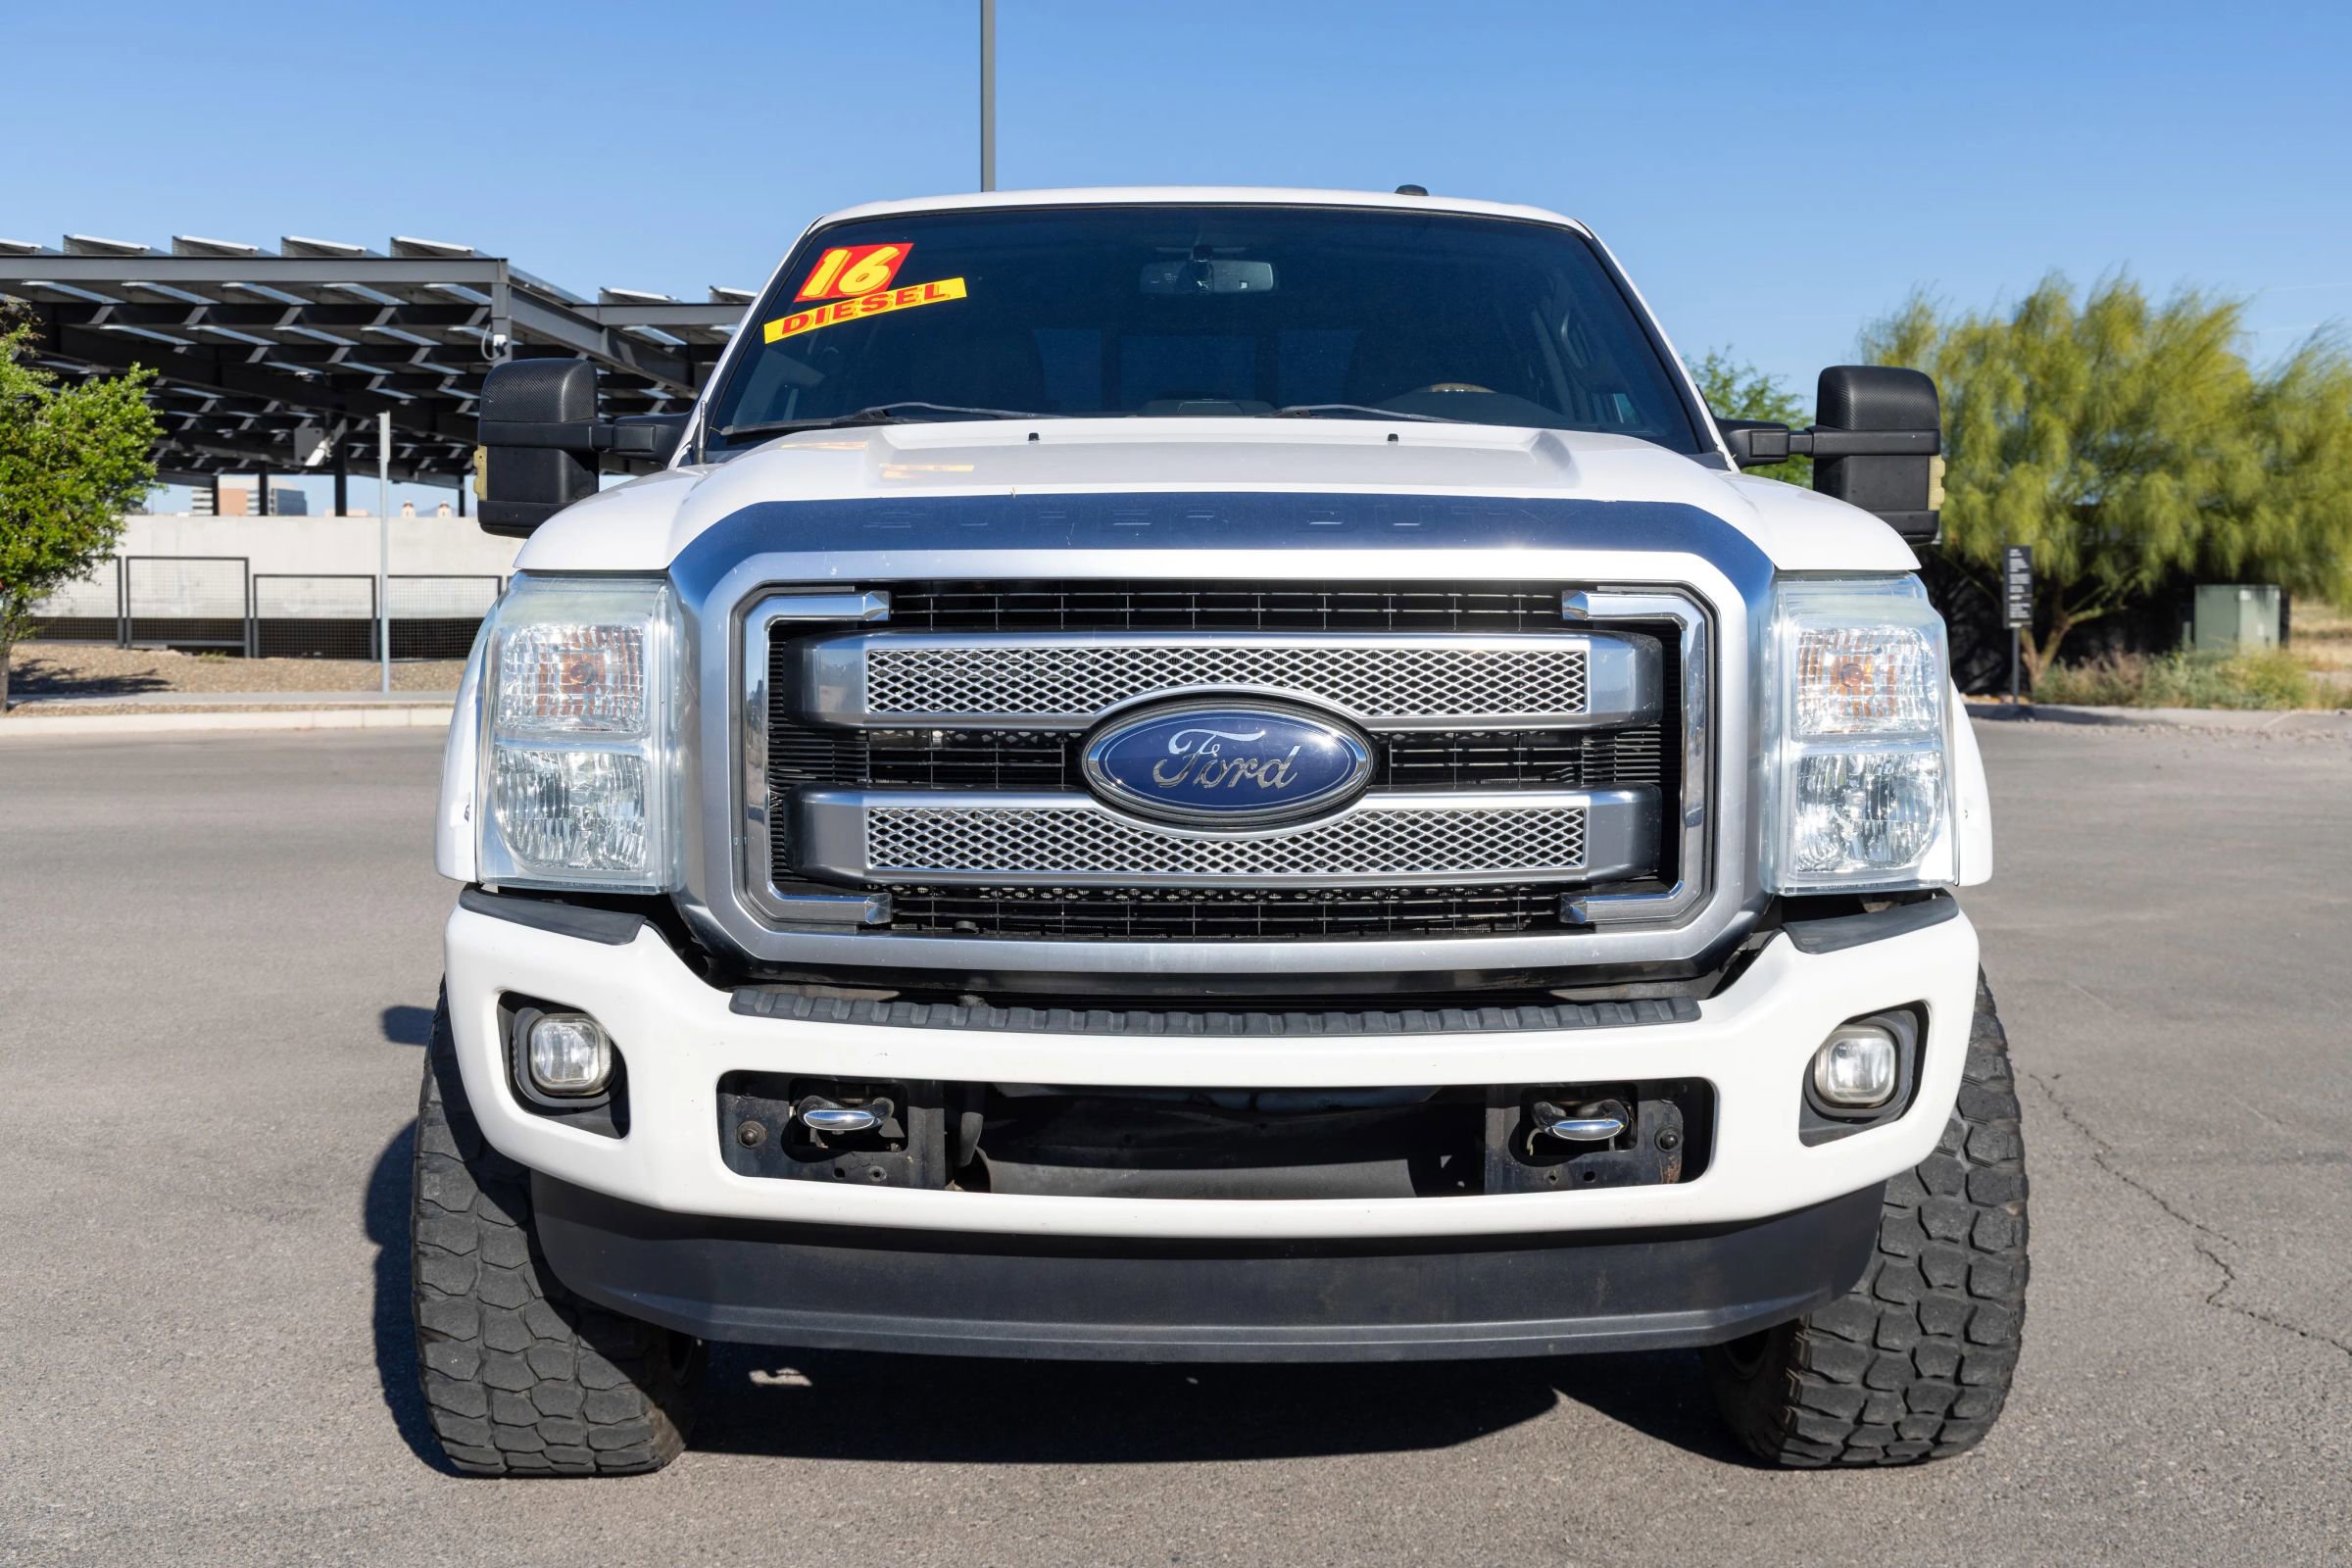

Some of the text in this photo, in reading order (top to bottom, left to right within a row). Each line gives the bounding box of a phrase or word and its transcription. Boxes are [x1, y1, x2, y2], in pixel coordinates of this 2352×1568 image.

[801, 246, 901, 298] 16
[781, 283, 951, 335] DIESEL
[1152, 728, 1301, 789] Ford
